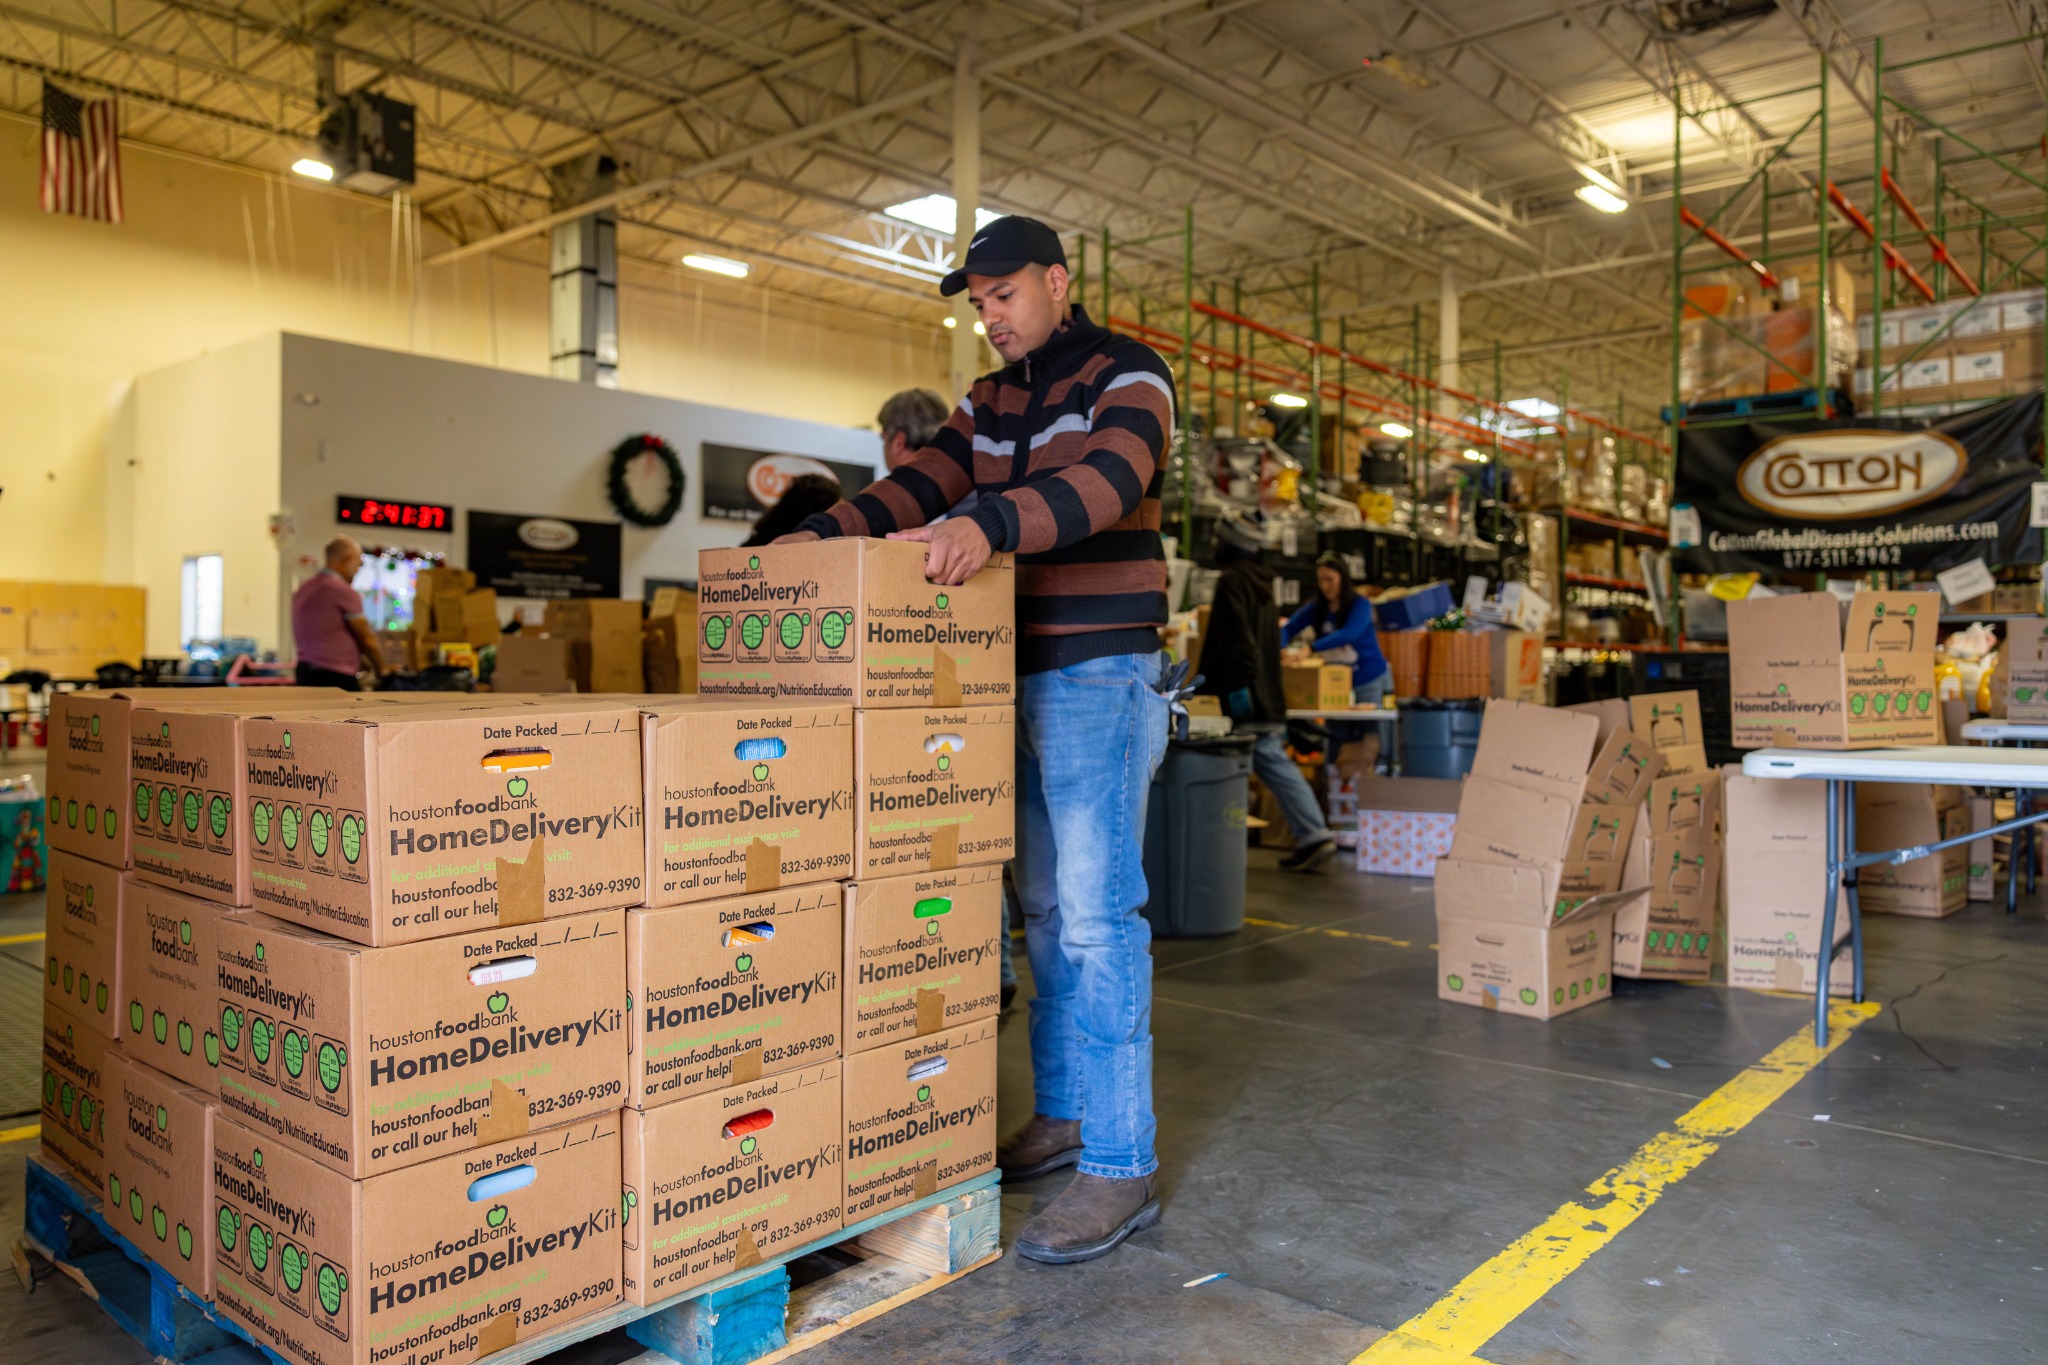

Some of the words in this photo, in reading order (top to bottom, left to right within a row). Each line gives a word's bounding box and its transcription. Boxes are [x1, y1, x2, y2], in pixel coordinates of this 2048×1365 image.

[1764, 451, 1922, 498] COTTON
[361, 500, 445, 529] 2:41:37
[701, 580, 819, 604] HomeDeliveryKit
[702, 568, 764, 582] houstonfoodbank
[868, 603, 953, 619] houstonfoodbank
[868, 622, 1013, 650] HomeDeliveryKit
[700, 682, 853, 698] houstonfoodbank.org/NutritionEducation
[866, 688, 876, 697] or
[880, 684, 894, 696] call
[896, 687, 910, 696] our
[962, 682, 1010, 694] 32-369-9390
[483, 726, 512, 740] Date
[516, 722, 558, 738] Packed
[737, 720, 758, 730] Date
[760, 716, 792, 729] Packed
[924, 716, 941, 725] Date
[943, 714, 968, 724] Packed
[132, 749, 208, 782] HomeDeliveryKit
[247, 744, 296, 760] houstonfoodbank
[248, 762, 338, 799] HomeDeliveryKit
[664, 777, 776, 800] houstonfoodbank
[870, 769, 955, 786] houstonfoodbank
[870, 780, 1014, 812] HomeDeliveryKit
[389, 792, 538, 822] houstonfoodbank
[664, 789, 853, 830] HomeDeliveryKit
[390, 804, 642, 856] HomeDeliveryKit
[664, 842, 679, 854] for
[682, 834, 731, 852] additional
[780, 828, 801, 840] visit:
[390, 868, 410, 884] for
[415, 858, 480, 880] additional
[547, 849, 573, 863] visit:
[868, 858, 878, 867] or
[881, 852, 896, 865] call
[898, 853, 912, 862] our
[958, 837, 1013, 854] 832-369-9390
[664, 882, 676, 892] or
[680, 874, 700, 889] call
[702, 874, 722, 886] our
[780, 853, 851, 874] 832-369-9390
[916, 882, 931, 892] Date
[933, 876, 956, 889] Packed
[146, 904, 178, 936] houston
[252, 882, 370, 928] houstonfoodbank.org/NutritionEducation
[392, 915, 409, 928] or
[414, 906, 439, 924] call
[444, 906, 469, 920] our
[549, 877, 642, 904] 832-369-9390
[719, 911, 740, 924] Date
[743, 902, 776, 920] Packed
[152, 930, 198, 966] foodbank
[217, 943, 268, 974] houstonfoodbank
[464, 945, 492, 959] Date
[496, 932, 538, 953] Packed
[860, 932, 944, 959] houstonfoodbank
[218, 964, 315, 1020] HomeDeliveryKit
[646, 966, 760, 1003] houstonfoodbank
[646, 970, 836, 1032] HomeDeliveryKit
[370, 1006, 518, 1052] houstonfoodbank
[856, 1029, 867, 1039] or
[870, 1022, 884, 1038] call
[886, 1021, 901, 1032] our
[946, 994, 999, 1017] 832-369-9390
[370, 1008, 622, 1086] HomeDeliveryKit
[646, 1082, 658, 1096] or
[662, 1073, 681, 1091] call
[684, 1070, 704, 1084] our
[763, 1034, 834, 1064] 832-369-9390
[905, 1049, 922, 1060] Date
[923, 1038, 948, 1055] Packed
[123, 1078, 154, 1119] houston
[370, 1102, 390, 1118] for
[394, 1081, 459, 1111] additional
[723, 1094, 744, 1108] Date
[746, 1082, 778, 1102] Packed
[128, 1107, 173, 1156] foodbank
[220, 1086, 348, 1162] houstonfoodbank.org/NutritionEducation
[371, 1144, 388, 1160] or
[392, 1131, 419, 1152] call
[423, 1128, 448, 1146] our
[528, 1080, 622, 1118] 832-369-9390
[848, 1096, 936, 1134] houstonfoodbank
[848, 1095, 994, 1160] HomeDeliveryKit
[214, 1146, 267, 1183] houstonfoodbank
[464, 1160, 493, 1176] Date
[496, 1142, 538, 1166] Packed
[652, 1148, 764, 1196] houstonfoodbank
[214, 1162, 316, 1238] HomeDeliveryKit
[652, 1144, 842, 1226] HomeDeliveryKit
[848, 1204, 858, 1214] or
[860, 1196, 874, 1210] call
[877, 1194, 892, 1204] our
[937, 1151, 992, 1181] 832-369-9390
[652, 1236, 668, 1250] for
[670, 1216, 720, 1245] additional
[722, 1202, 768, 1226] assistance
[770, 1194, 790, 1208] visit:
[370, 1218, 518, 1281] houstonfoodbank
[370, 1208, 617, 1314] HomeDeliveryKit
[652, 1275, 666, 1289] or
[668, 1262, 688, 1282] call
[692, 1258, 710, 1274] our
[756, 1236, 768, 1248] at
[770, 1206, 840, 1243] 832-369-9390
[522, 1278, 614, 1326] 832-369-9390
[370, 1297, 522, 1364] houstonfoodbank.org
